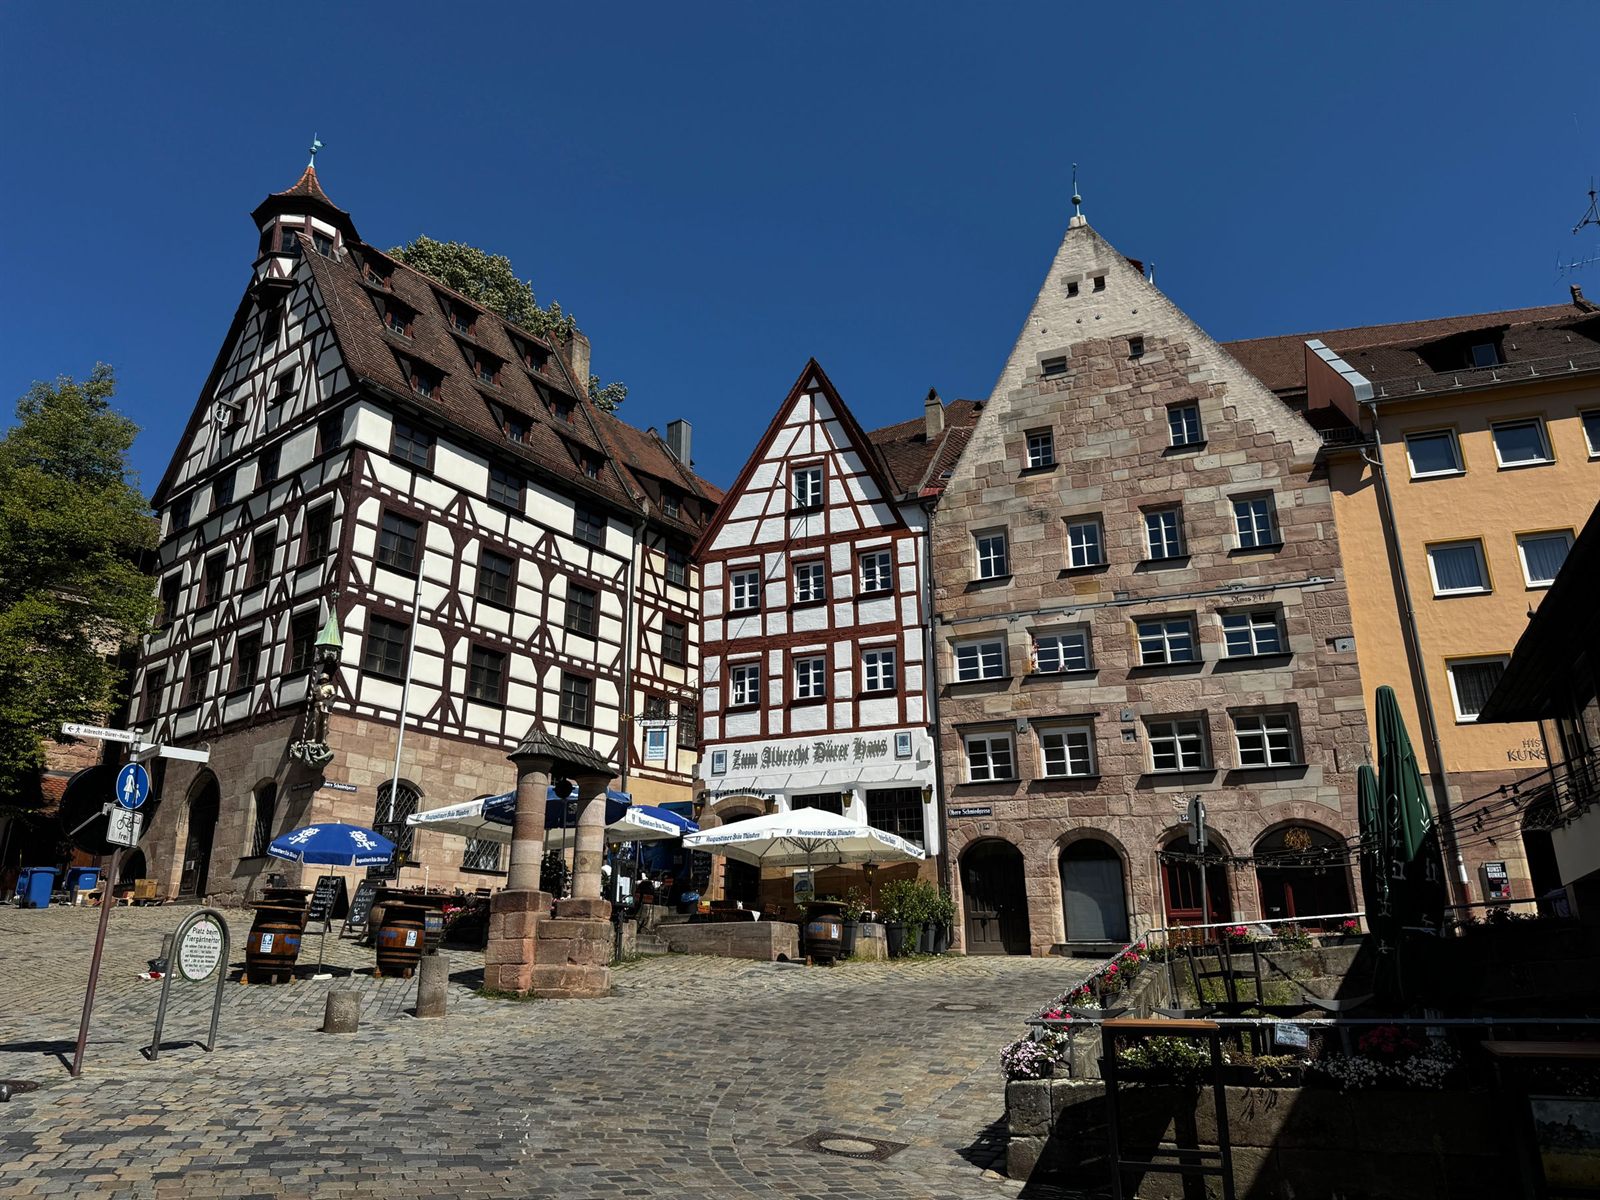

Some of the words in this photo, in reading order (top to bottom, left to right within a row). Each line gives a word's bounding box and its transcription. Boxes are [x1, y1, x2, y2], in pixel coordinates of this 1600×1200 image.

[83, 728, 130, 739] Albrecht-Dürer-Haus
[1522, 738, 1544, 748] HIS
[732, 749, 758, 770] Zum
[760, 744, 810, 769] Albrecht
[812, 740, 849, 764] Dürer
[852, 737, 888, 764] Haus
[118, 831, 129, 841] frei
[192, 927, 205, 935] Platz
[187, 935, 220, 944] Tiergärtnertor
